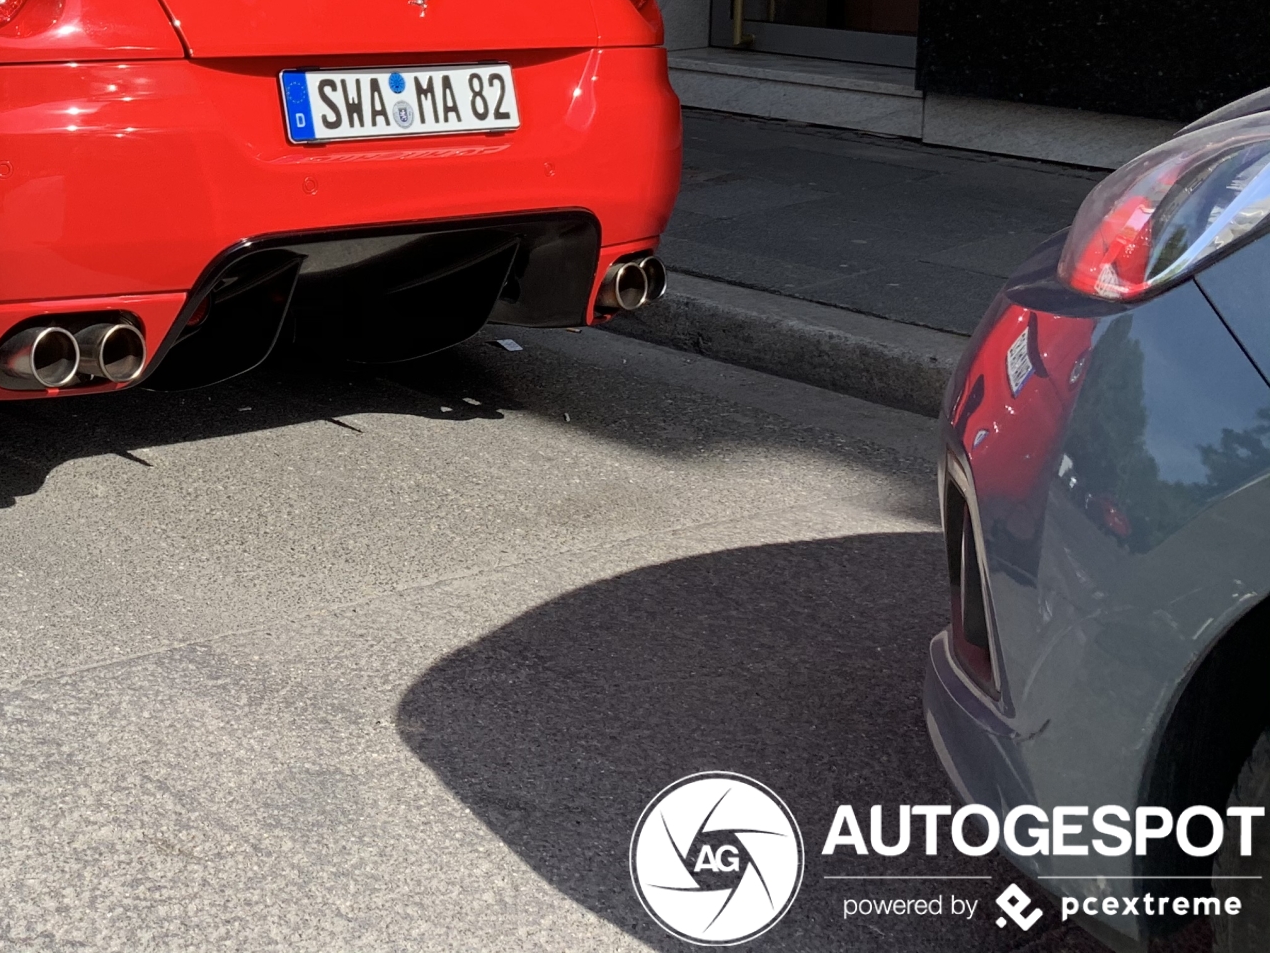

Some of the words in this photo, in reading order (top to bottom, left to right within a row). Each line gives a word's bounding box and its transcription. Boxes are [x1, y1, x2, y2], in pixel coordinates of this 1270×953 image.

[317, 77, 392, 130] SWA
[414, 74, 462, 124] MA
[468, 72, 512, 122] 82
[296, 112, 306, 128] D
